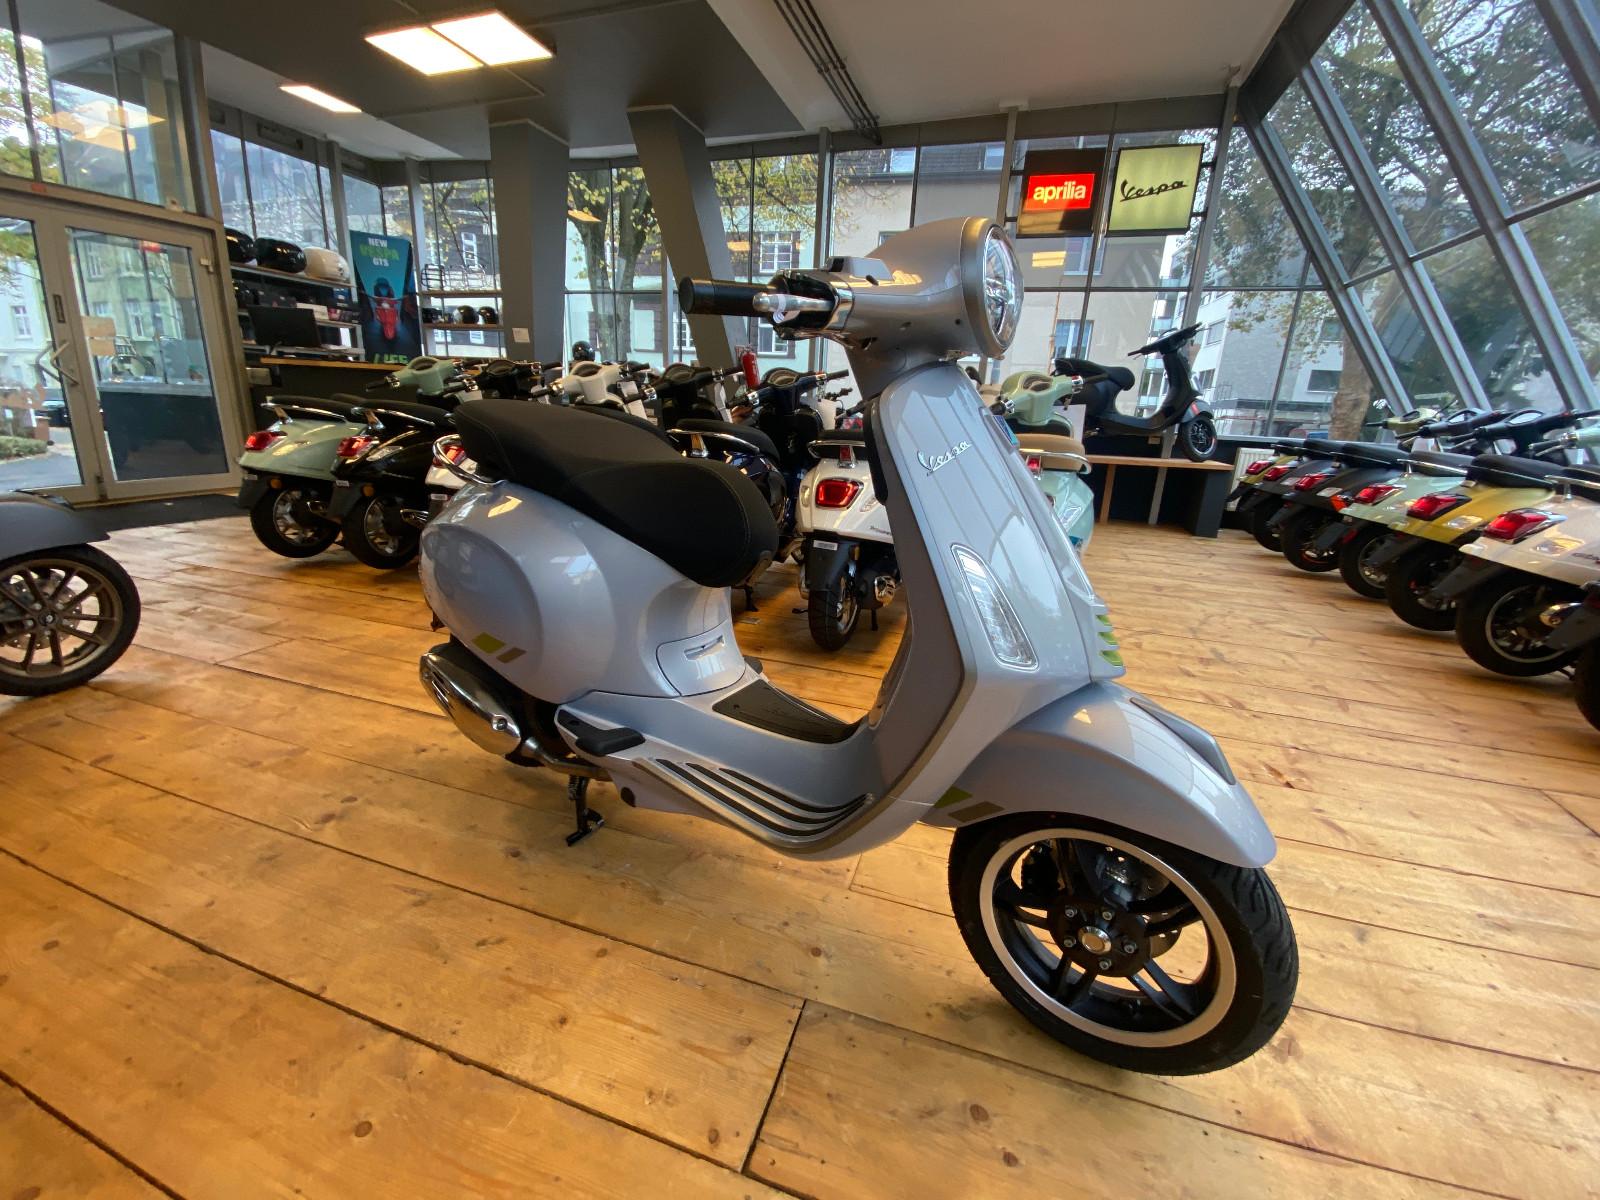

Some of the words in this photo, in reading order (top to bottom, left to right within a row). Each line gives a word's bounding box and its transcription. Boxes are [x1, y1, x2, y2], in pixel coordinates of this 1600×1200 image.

[1033, 181, 1086, 204] aprilia
[1120, 180, 1188, 202] Vespa
[368, 237, 388, 247] NEW
[372, 257, 389, 267] GTS
[917, 440, 973, 476] Vespa
